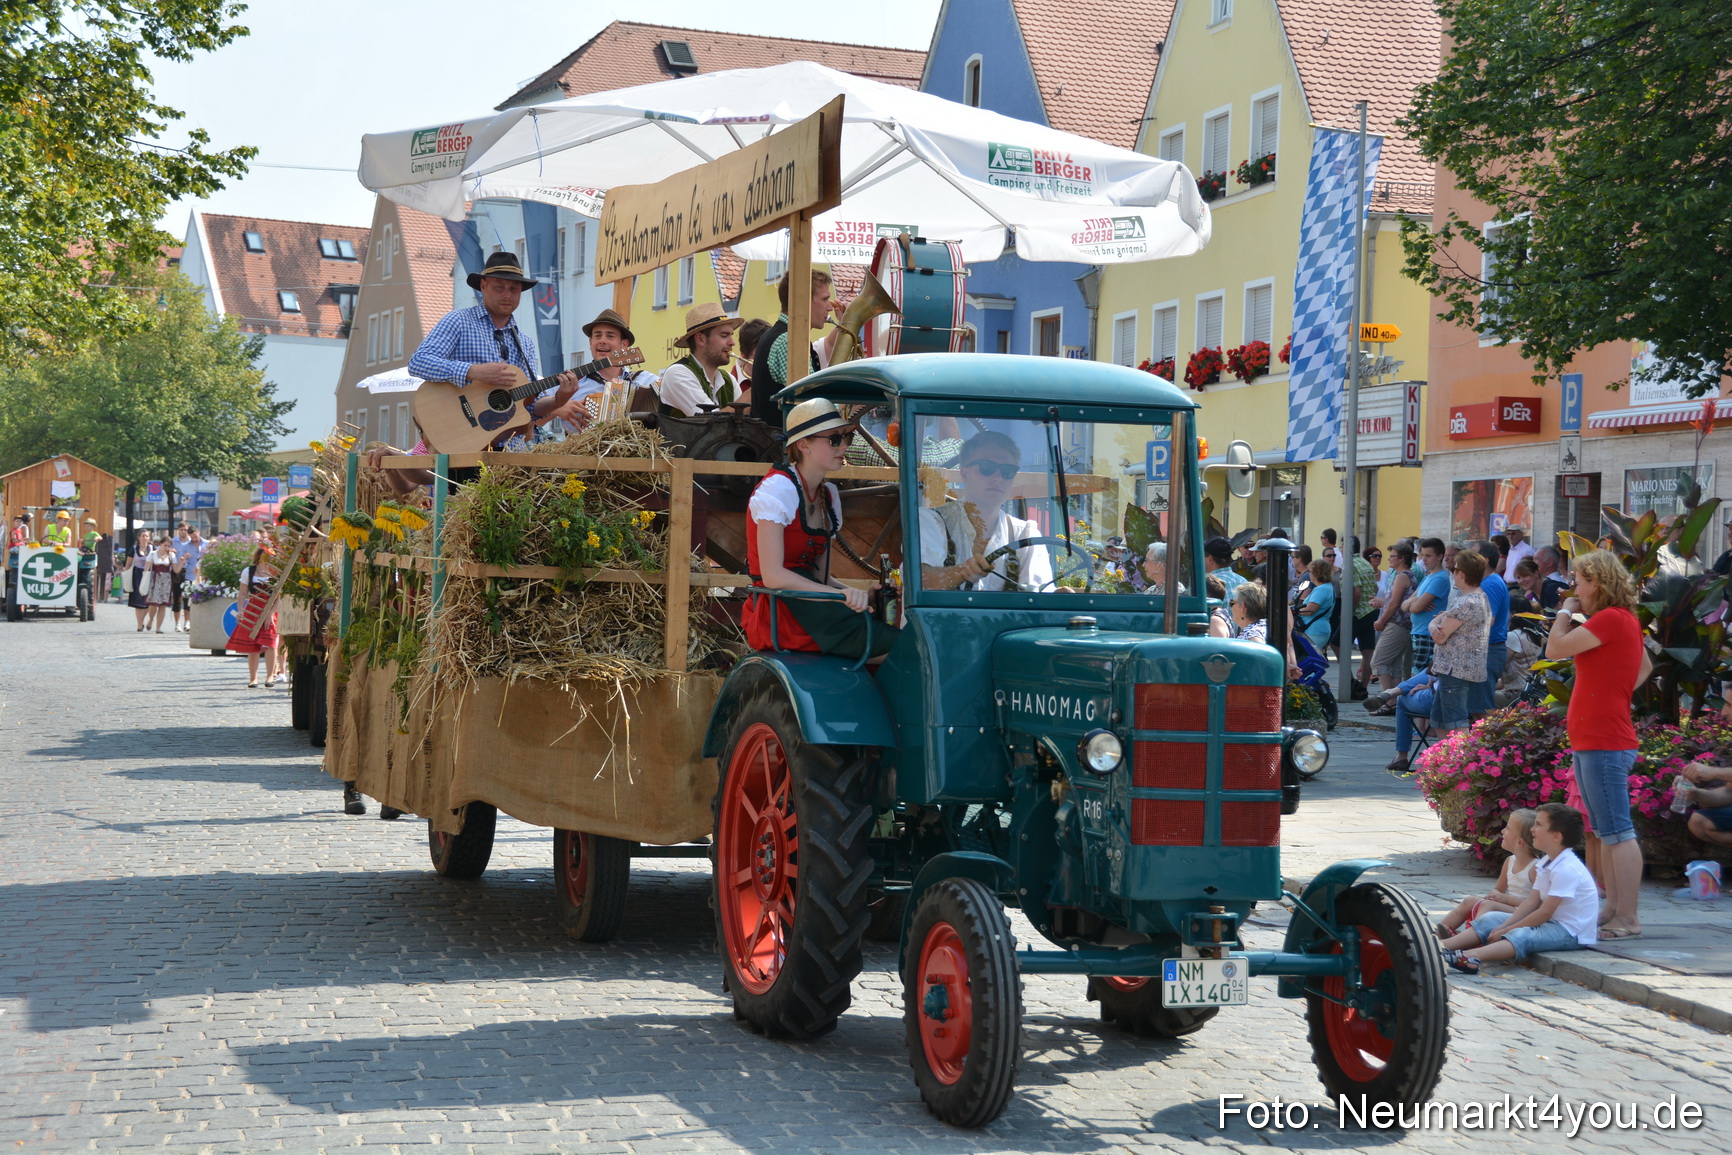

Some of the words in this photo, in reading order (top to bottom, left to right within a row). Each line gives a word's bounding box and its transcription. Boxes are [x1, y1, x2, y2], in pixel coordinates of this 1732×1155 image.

[438, 123, 465, 138] FRITZ
[1034, 149, 1073, 163] FRITZ
[1034, 160, 1092, 181] BERGER
[988, 174, 1031, 193] Camping
[1034, 180, 1052, 190] und
[1056, 181, 1092, 196] Freizeit
[712, 190, 735, 236] uns
[1359, 327, 1379, 339] INO
[1407, 386, 1418, 459] KINO
[1503, 407, 1532, 421] DER
[1374, 416, 1392, 433] KINO
[1450, 418, 1467, 434] DER
[1632, 480, 1658, 492] MARIO
[27, 583, 50, 596] KLJB
[332, 686, 347, 740] Seubersdorf
[1012, 691, 1095, 721] HANOMAG
[1179, 962, 1203, 981] NM
